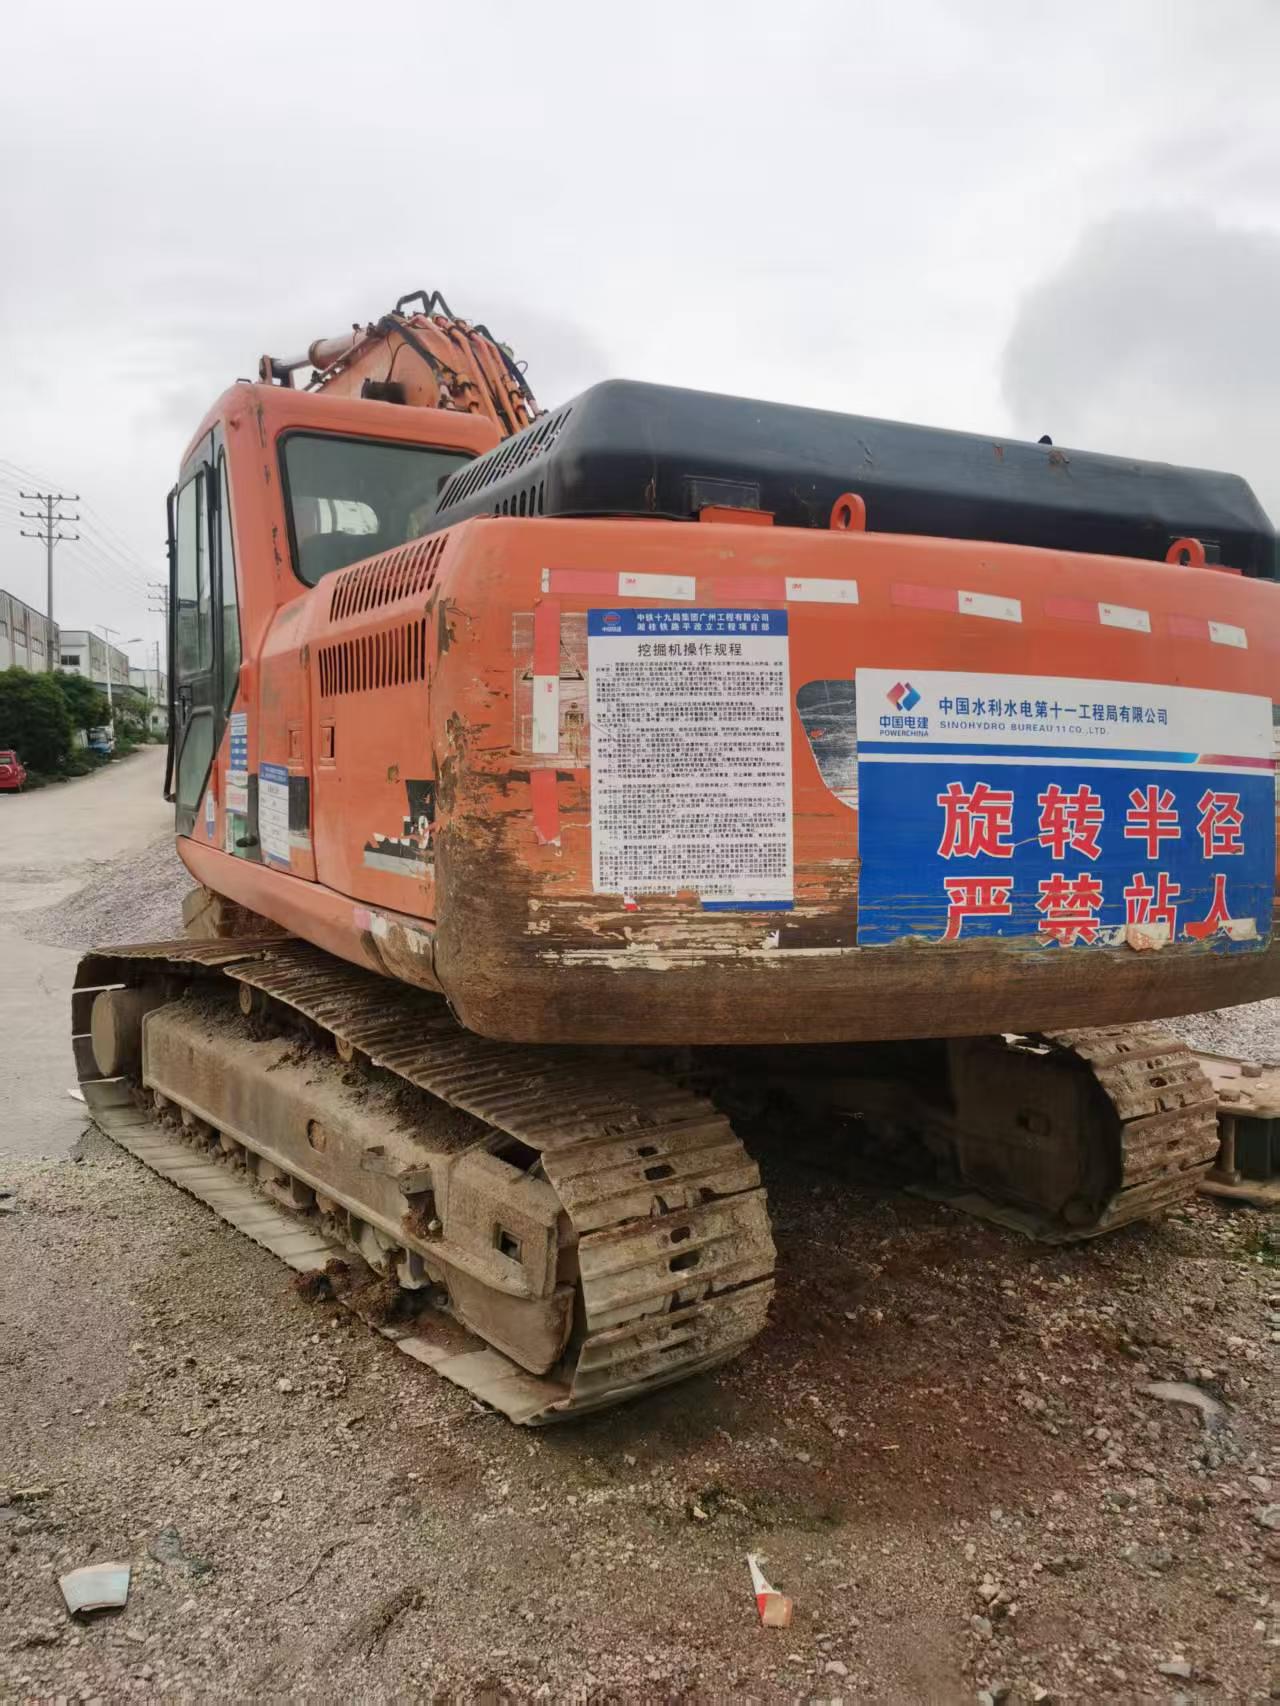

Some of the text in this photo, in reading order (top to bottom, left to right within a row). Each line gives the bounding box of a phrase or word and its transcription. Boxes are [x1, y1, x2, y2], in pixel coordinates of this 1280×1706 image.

[637, 643, 743, 657] 挖掘机操作规程
[939, 695, 1168, 725] 中国水利水电第十一工程局有限公司
[879, 715, 929, 729] 中国电建
[939, 720, 1006, 730] SINOHYDRO
[879, 729, 929, 737] POWERCHINA
[937, 781, 1244, 860] 旋转半径
[939, 872, 1234, 946] 严禁站人
